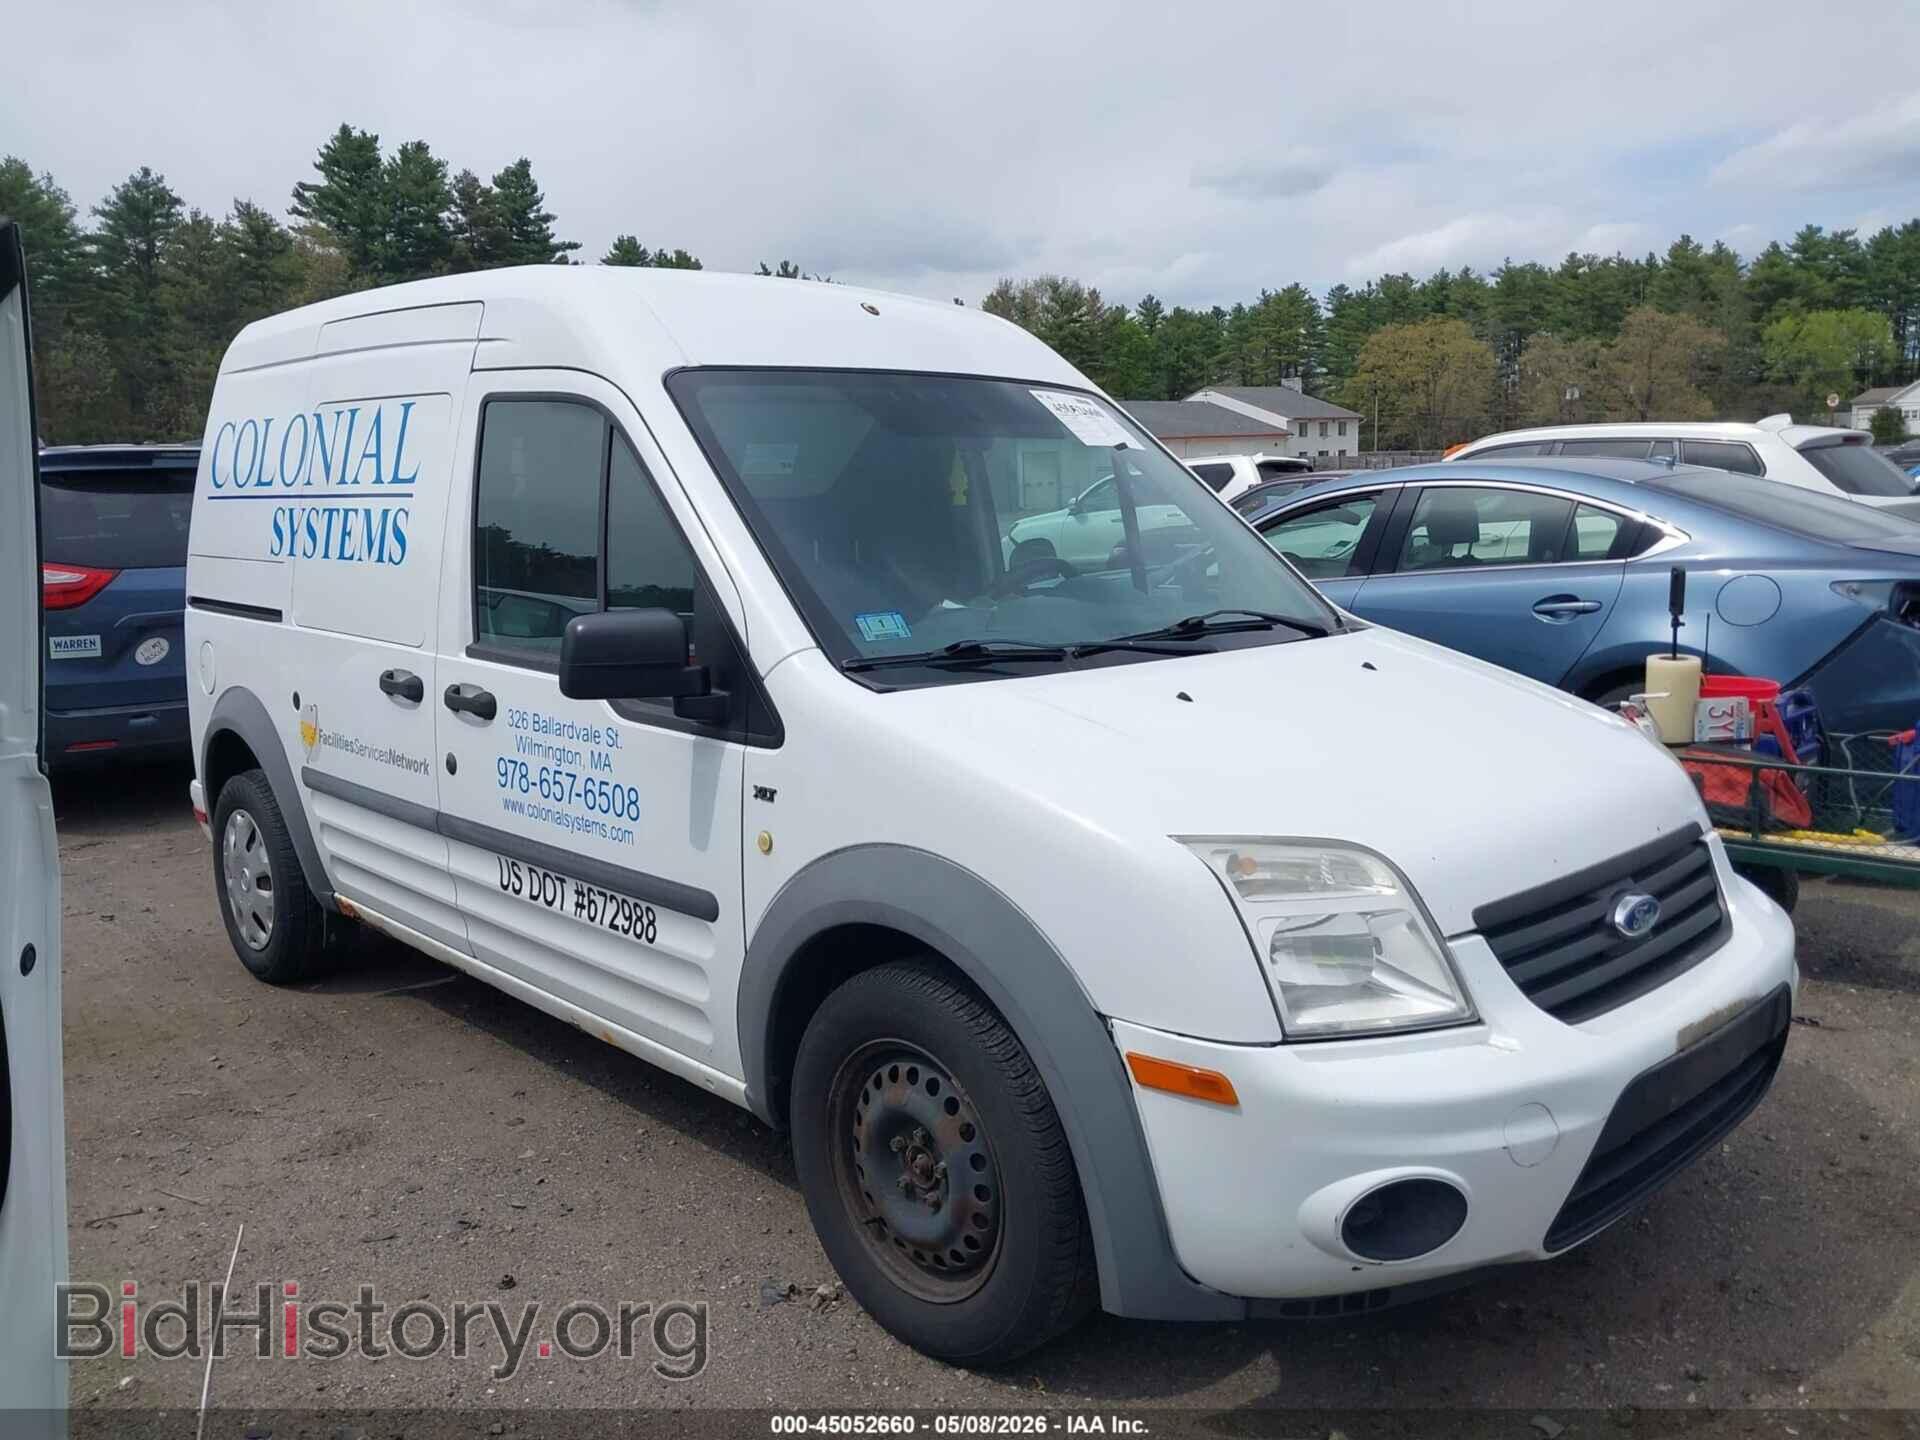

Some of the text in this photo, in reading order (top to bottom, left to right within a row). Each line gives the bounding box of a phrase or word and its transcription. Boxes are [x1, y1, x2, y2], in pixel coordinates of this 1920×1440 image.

[211, 401, 423, 489] COLONIAL
[270, 506, 409, 566] SYSTEMS
[53, 638, 97, 650] WARREN
[507, 708, 623, 749] 326 Ballardvale St.
[515, 734, 612, 772] Wilmington, MA
[497, 757, 640, 821] 978-657-6508
[503, 798, 634, 845] www.colonialsystems.com
[497, 856, 657, 944] US DOT #672988
